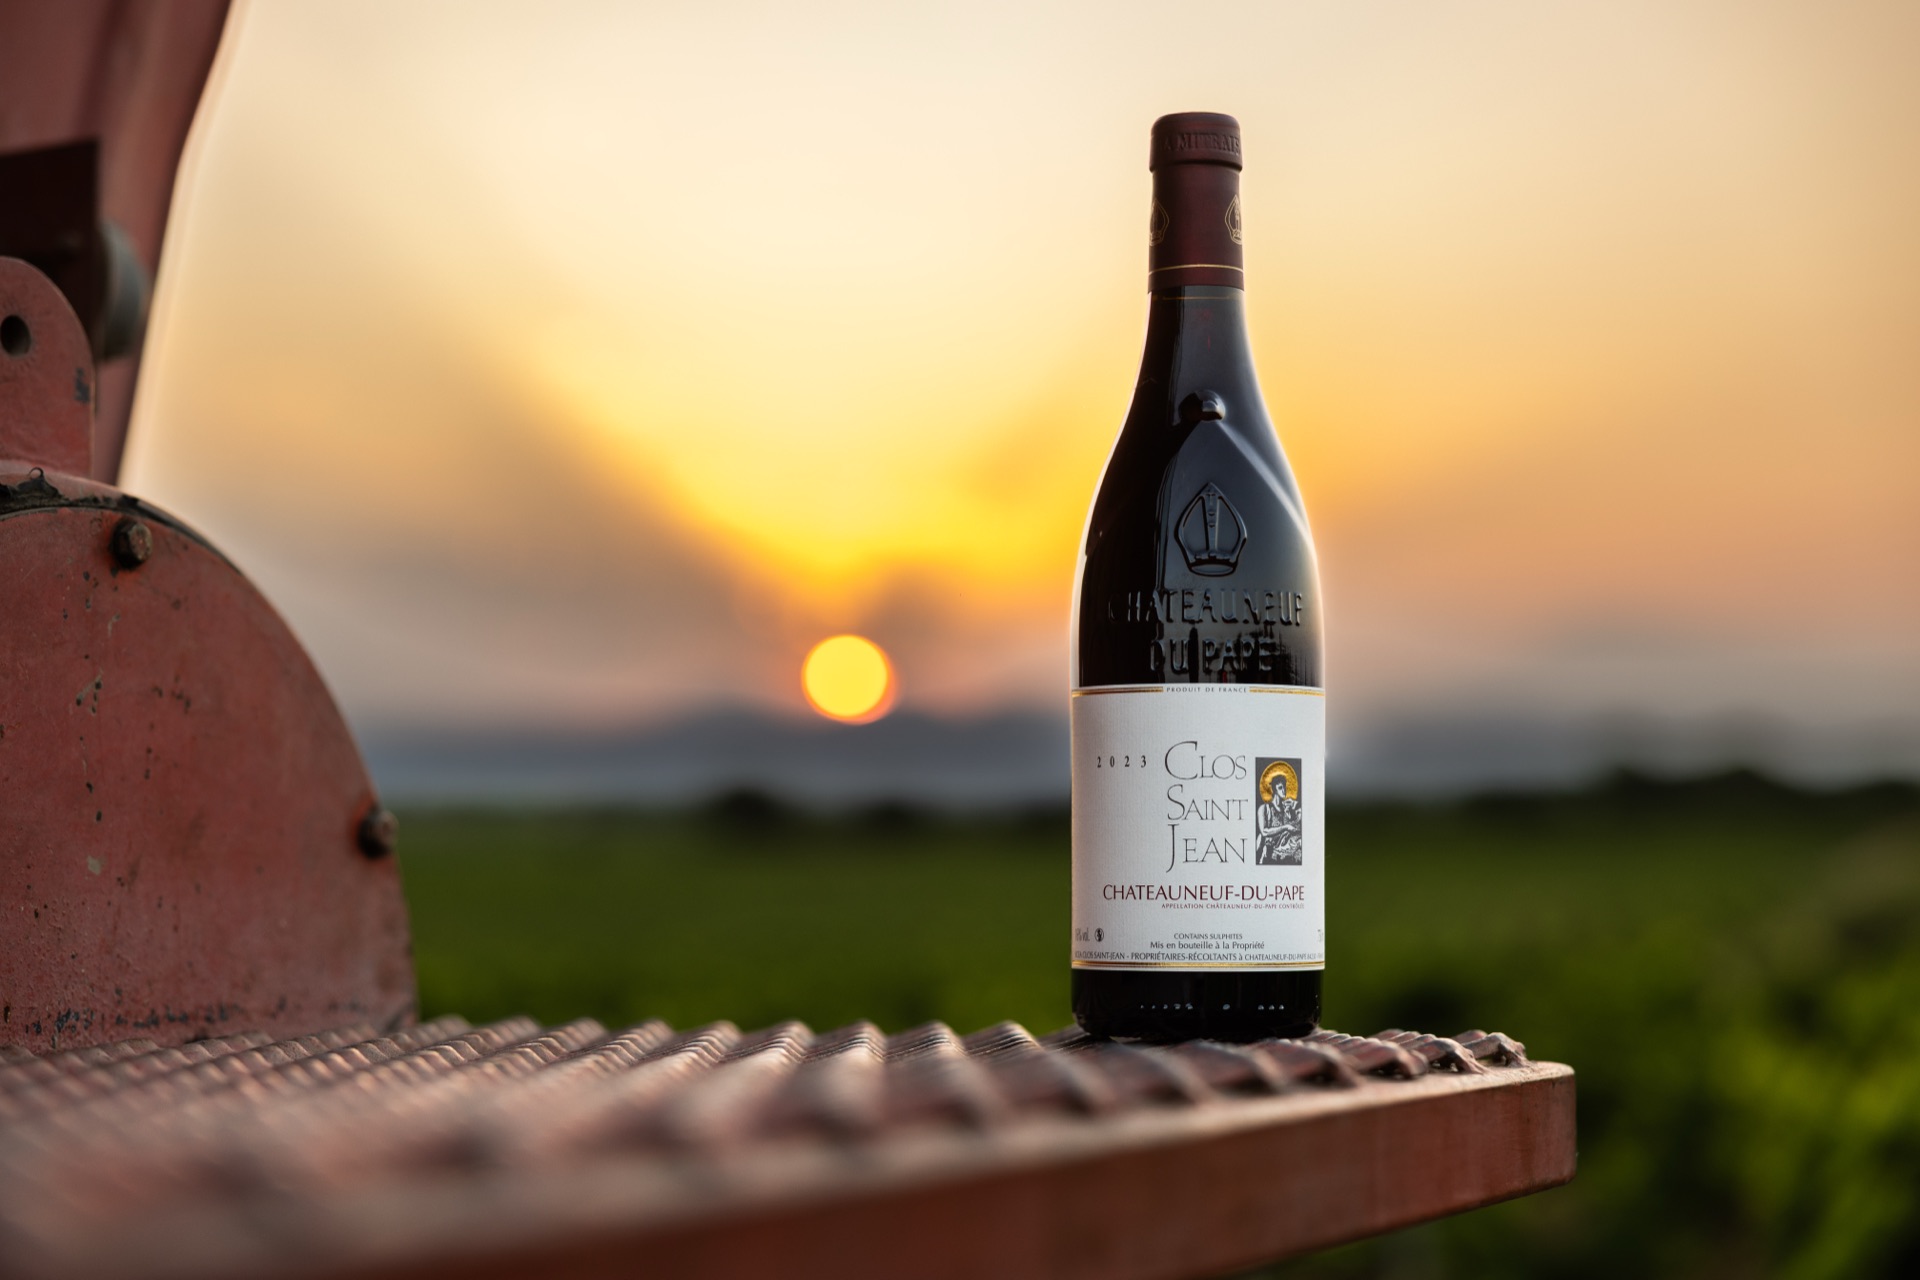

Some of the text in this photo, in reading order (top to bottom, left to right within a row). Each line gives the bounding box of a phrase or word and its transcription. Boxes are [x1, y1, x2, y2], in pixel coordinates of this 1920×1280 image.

[1108, 588, 1302, 626] CHATEAUNEUF
[1150, 637, 1279, 674] DU PAPE
[1096, 754, 1147, 768] 2023
[1164, 740, 1247, 780] CLOS
[1166, 784, 1248, 821] SAINT
[1165, 824, 1248, 873] JEAN
[1103, 884, 1305, 901] CHATEAUNEUF-DU-PAPE
[1150, 941, 1164, 949] Mis
[1178, 941, 1213, 950] bouteille
[1215, 941, 1220, 950] à
[1222, 941, 1230, 950] la
[1232, 941, 1265, 952] Propriété
[1173, 932, 1243, 940] CONTAINS SULPHITES
[1094, 951, 1125, 960] SAINT-JEAN
[1131, 951, 1237, 960] PROPRIÉTAIRES-RÉCOLTANTS
